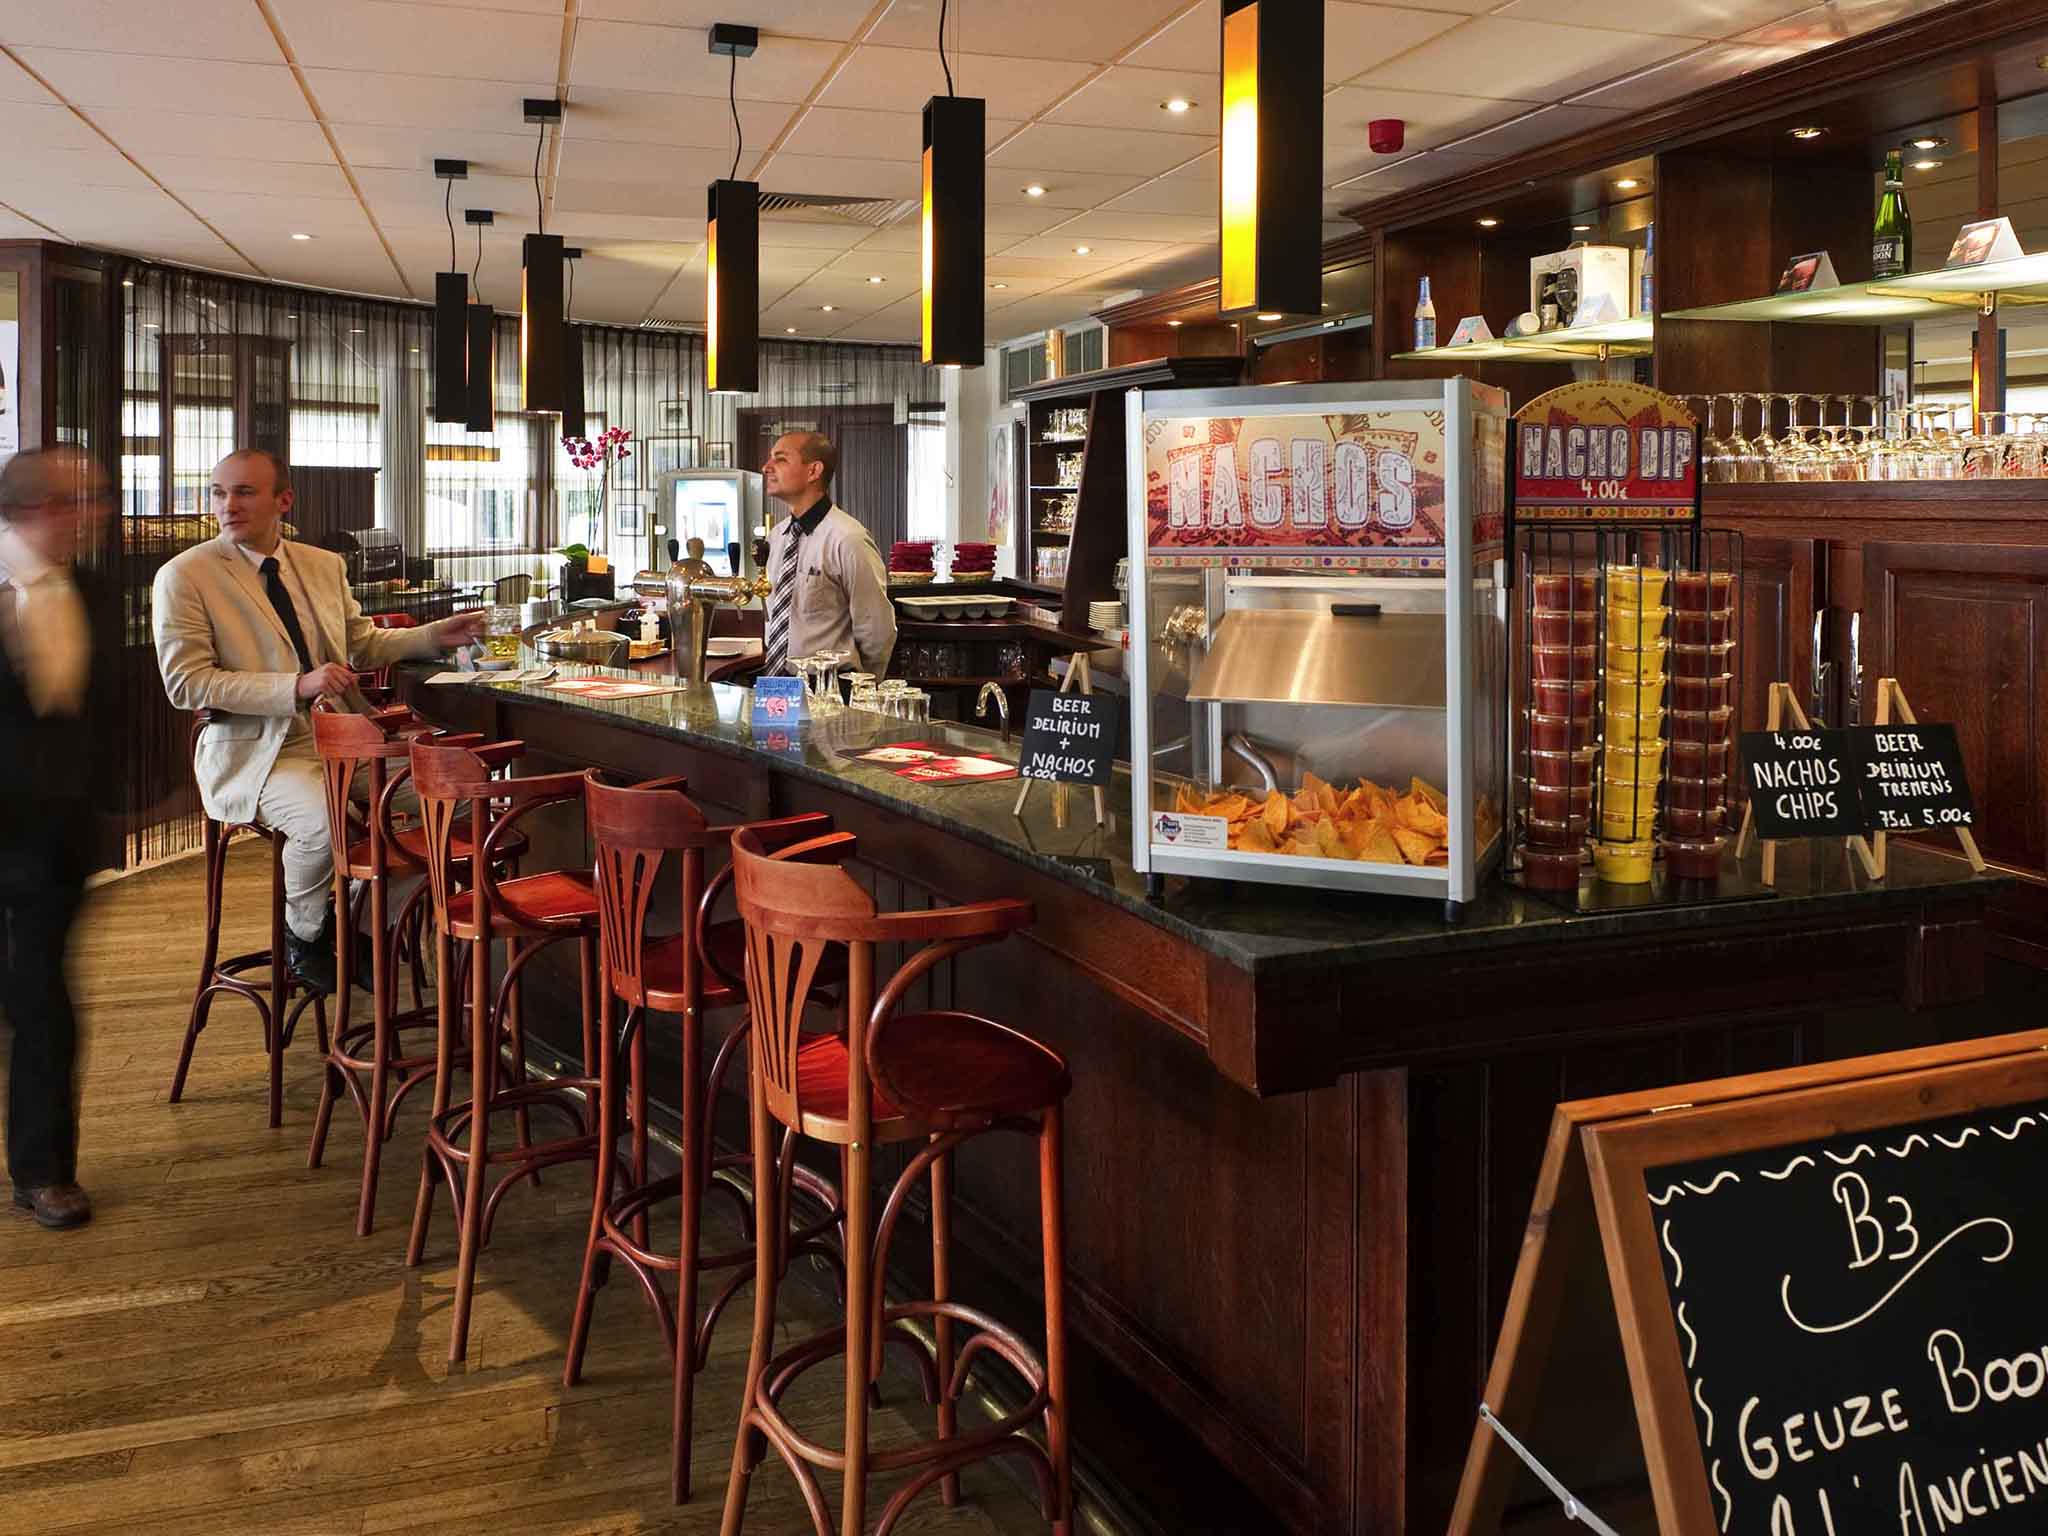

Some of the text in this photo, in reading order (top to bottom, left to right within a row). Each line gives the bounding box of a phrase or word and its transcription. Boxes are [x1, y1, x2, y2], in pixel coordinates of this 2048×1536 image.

[1521, 424, 1692, 480] NACHO DIP
[1168, 438, 1417, 529] NACHOS
[1581, 479, 1629, 500] 4.00€
[1052, 697, 1091, 714] BEER
[1773, 733, 1822, 750] 4.00€
[1875, 733, 1924, 753] BEER
[1032, 752, 1096, 777] NACHOS
[1753, 759, 1841, 789] NACHOS
[1879, 779, 1953, 798] TREMENS
[1923, 808, 1972, 825] 5.00€
[1832, 1171, 1919, 1268] B3
[1738, 1329, 2048, 1480] GEUZE BOO
